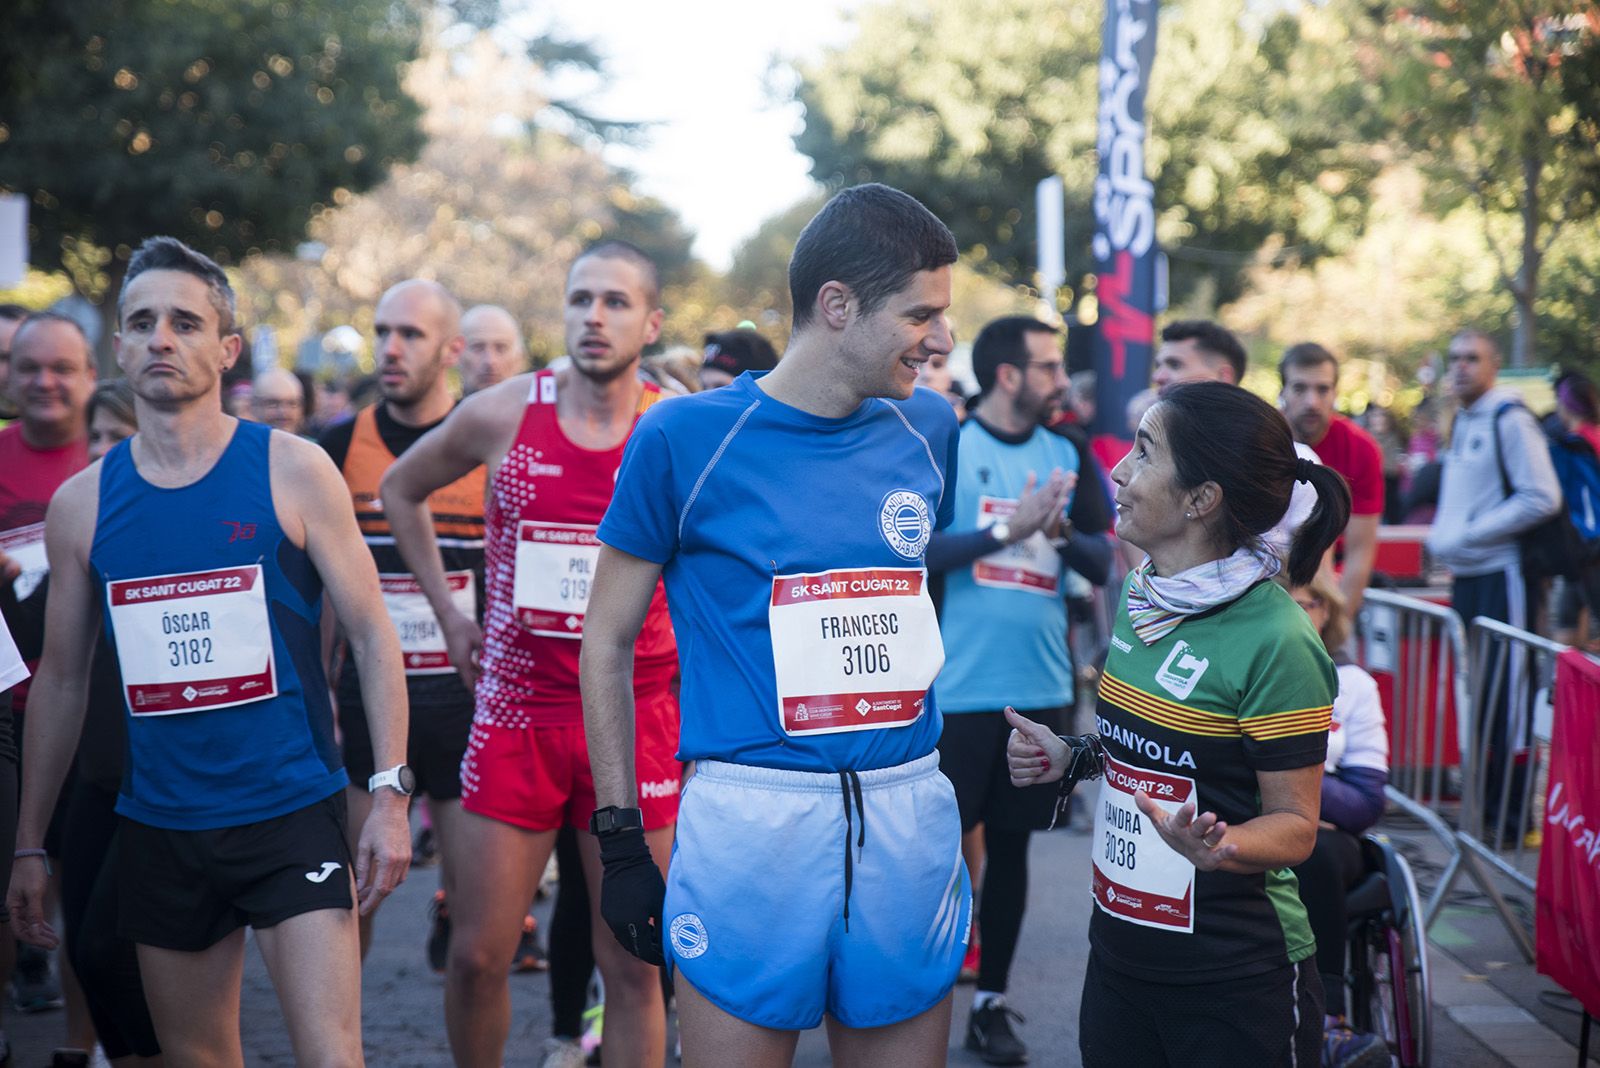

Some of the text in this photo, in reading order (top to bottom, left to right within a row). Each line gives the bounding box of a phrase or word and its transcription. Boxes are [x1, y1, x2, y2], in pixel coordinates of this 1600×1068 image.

[569, 557, 591, 574] POL
[125, 576, 241, 600] 5K SANT CUGAT 22
[791, 578, 910, 598] 5K SANT CUGAT 22
[162, 611, 211, 635] ÓSCAR
[820, 612, 899, 640] FRANCESC
[168, 637, 214, 667] 3182
[842, 643, 891, 676] 3106
[1117, 773, 1156, 793] CUGAT
[1156, 782, 1174, 797] 22
[1105, 830, 1136, 871] 3038
